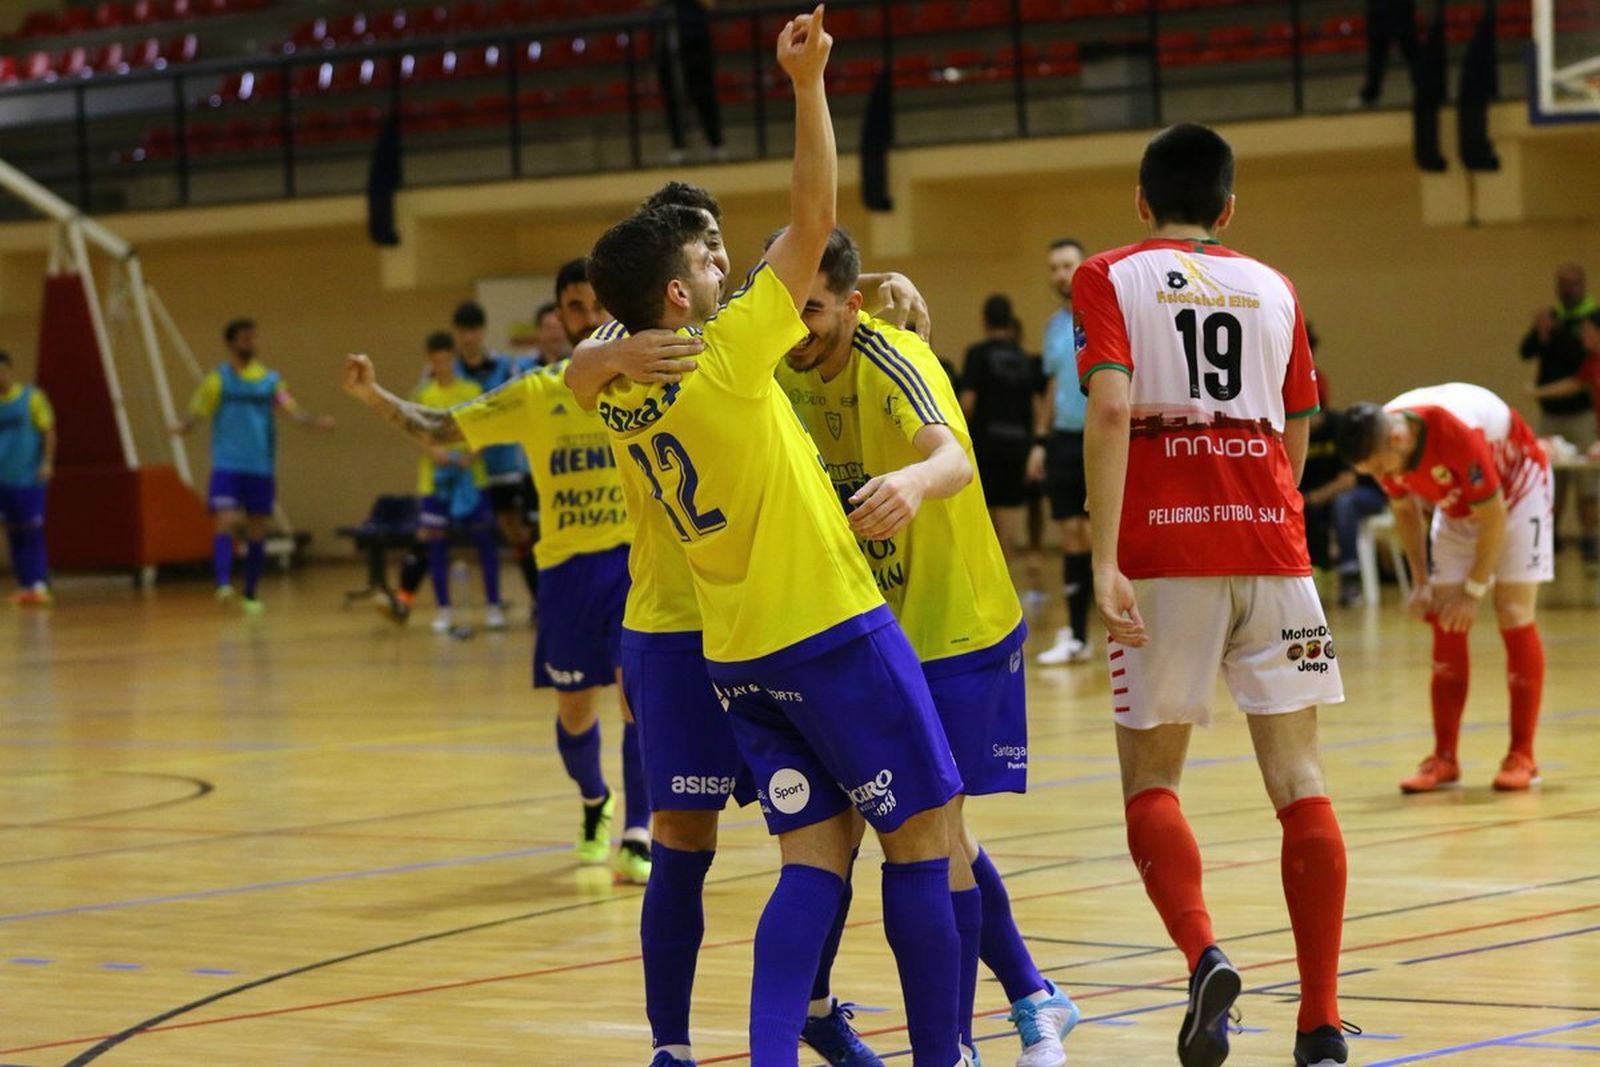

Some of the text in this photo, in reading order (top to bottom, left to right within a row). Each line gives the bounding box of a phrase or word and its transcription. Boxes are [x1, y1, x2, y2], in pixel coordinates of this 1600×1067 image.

[1175, 308, 1242, 402] 19
[551, 486, 624, 511] MOTO
[628, 432, 727, 542] 12
[558, 507, 627, 531] PAYA
[1149, 506, 1210, 526] PELIGROS
[1213, 504, 1257, 523] FUTBO
[1529, 517, 1541, 548] 7
[1297, 659, 1328, 674] Jeep
[992, 743, 1026, 760] Santaga
[774, 782, 805, 800] Sport
[876, 789, 897, 816] 1958
